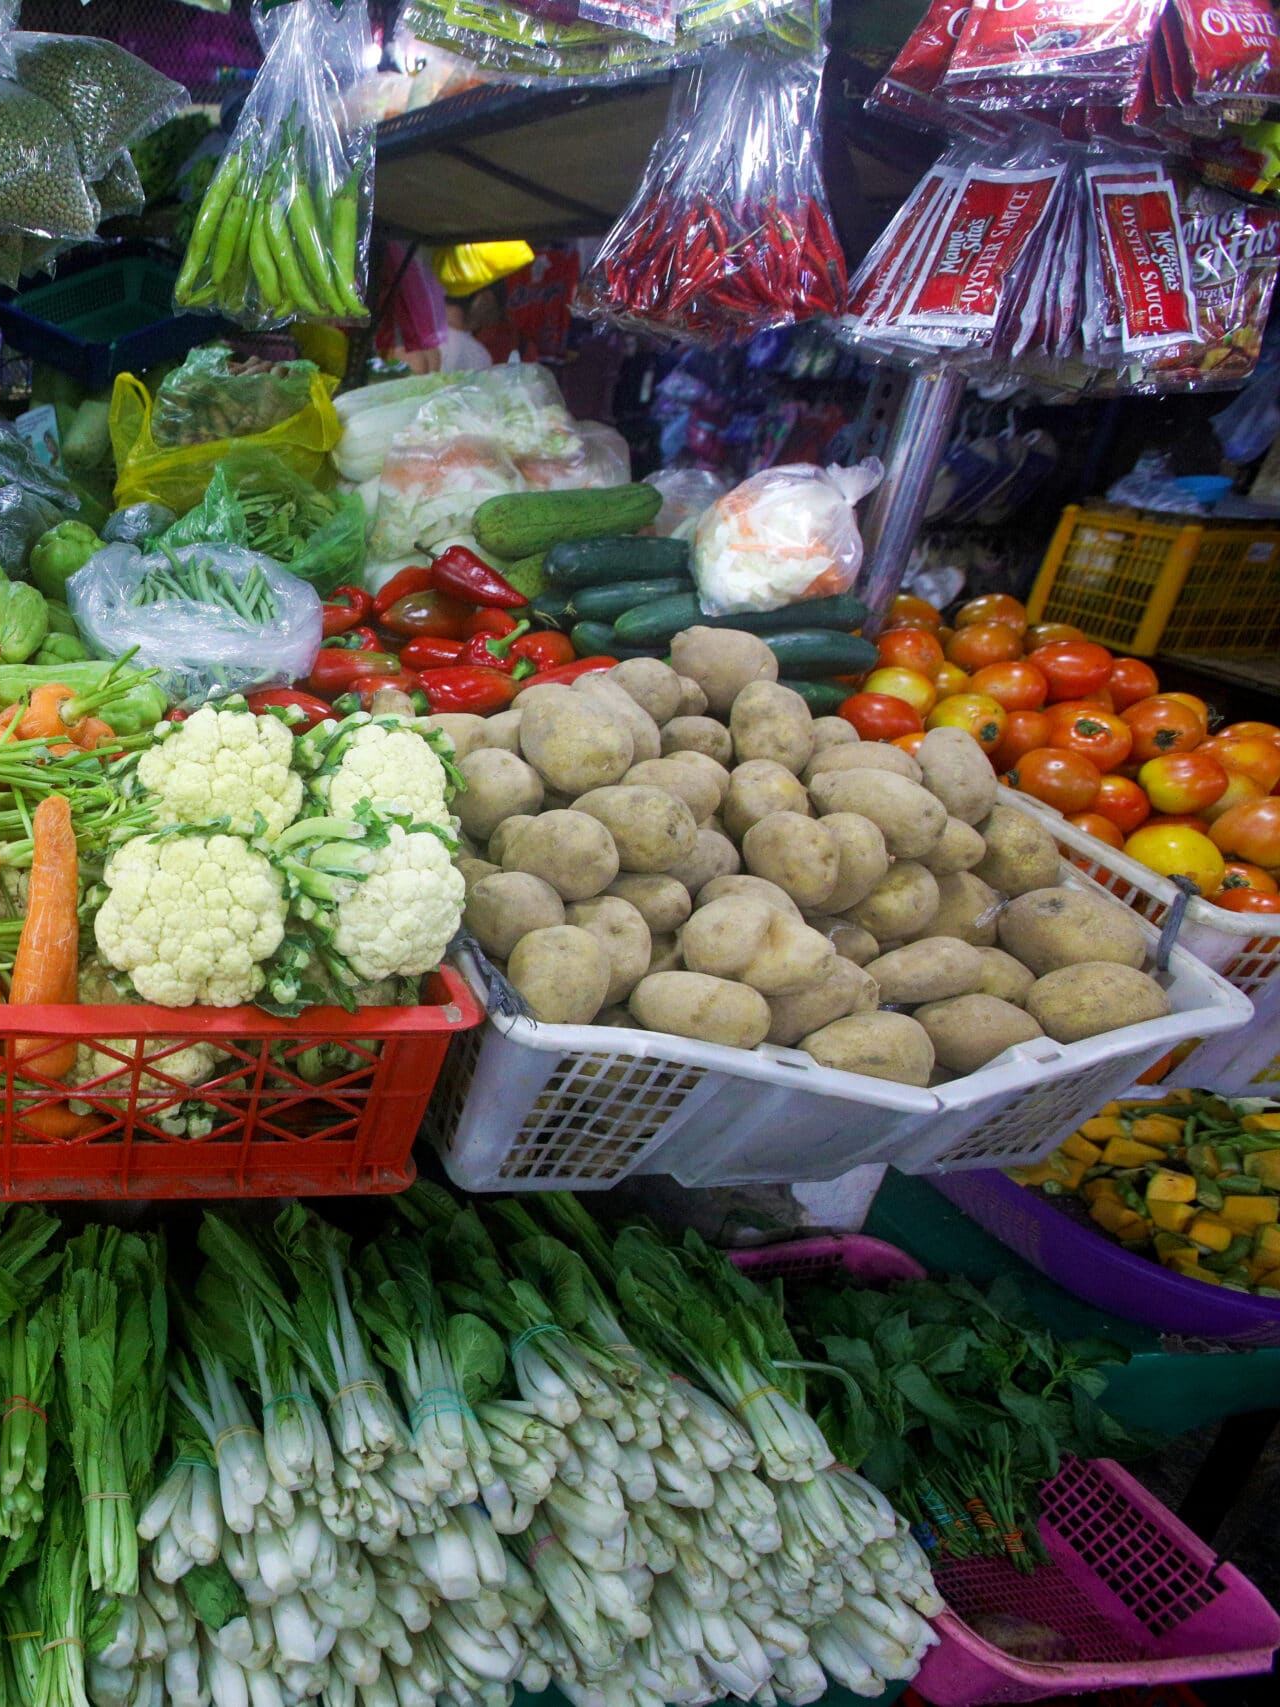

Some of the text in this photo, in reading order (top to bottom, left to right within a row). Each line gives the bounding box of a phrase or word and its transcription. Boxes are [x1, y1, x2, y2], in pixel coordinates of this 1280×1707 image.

[1201, 7, 1278, 36] OYSTE
[960, 190, 1033, 303] OYSTER SAUCE
[1182, 207, 1246, 246] ama
[939, 230, 964, 274] Mama
[1121, 205, 1164, 327] OYSTER SAUCE
